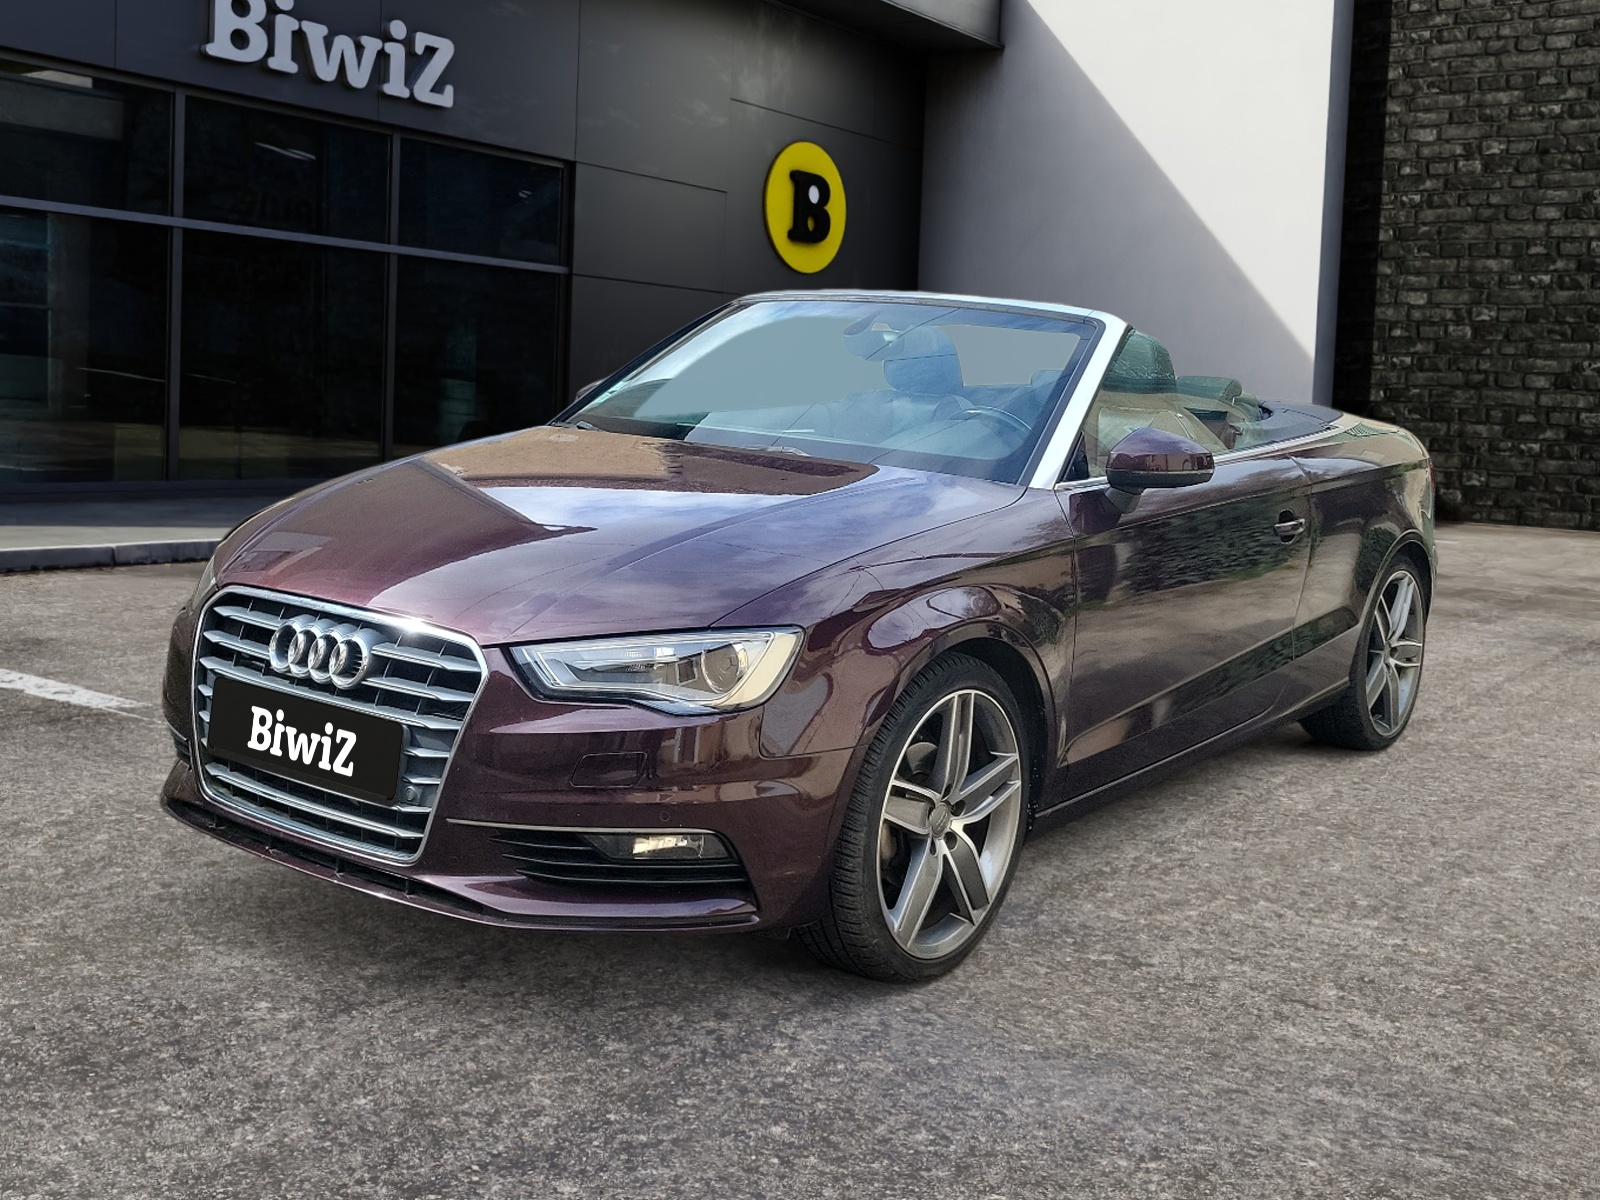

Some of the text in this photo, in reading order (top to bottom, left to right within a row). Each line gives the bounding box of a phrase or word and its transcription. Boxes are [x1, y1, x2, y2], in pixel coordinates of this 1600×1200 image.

[203, 0, 455, 108] BiwiZ
[787, 169, 831, 243] B
[247, 705, 357, 777] BiwiZ
